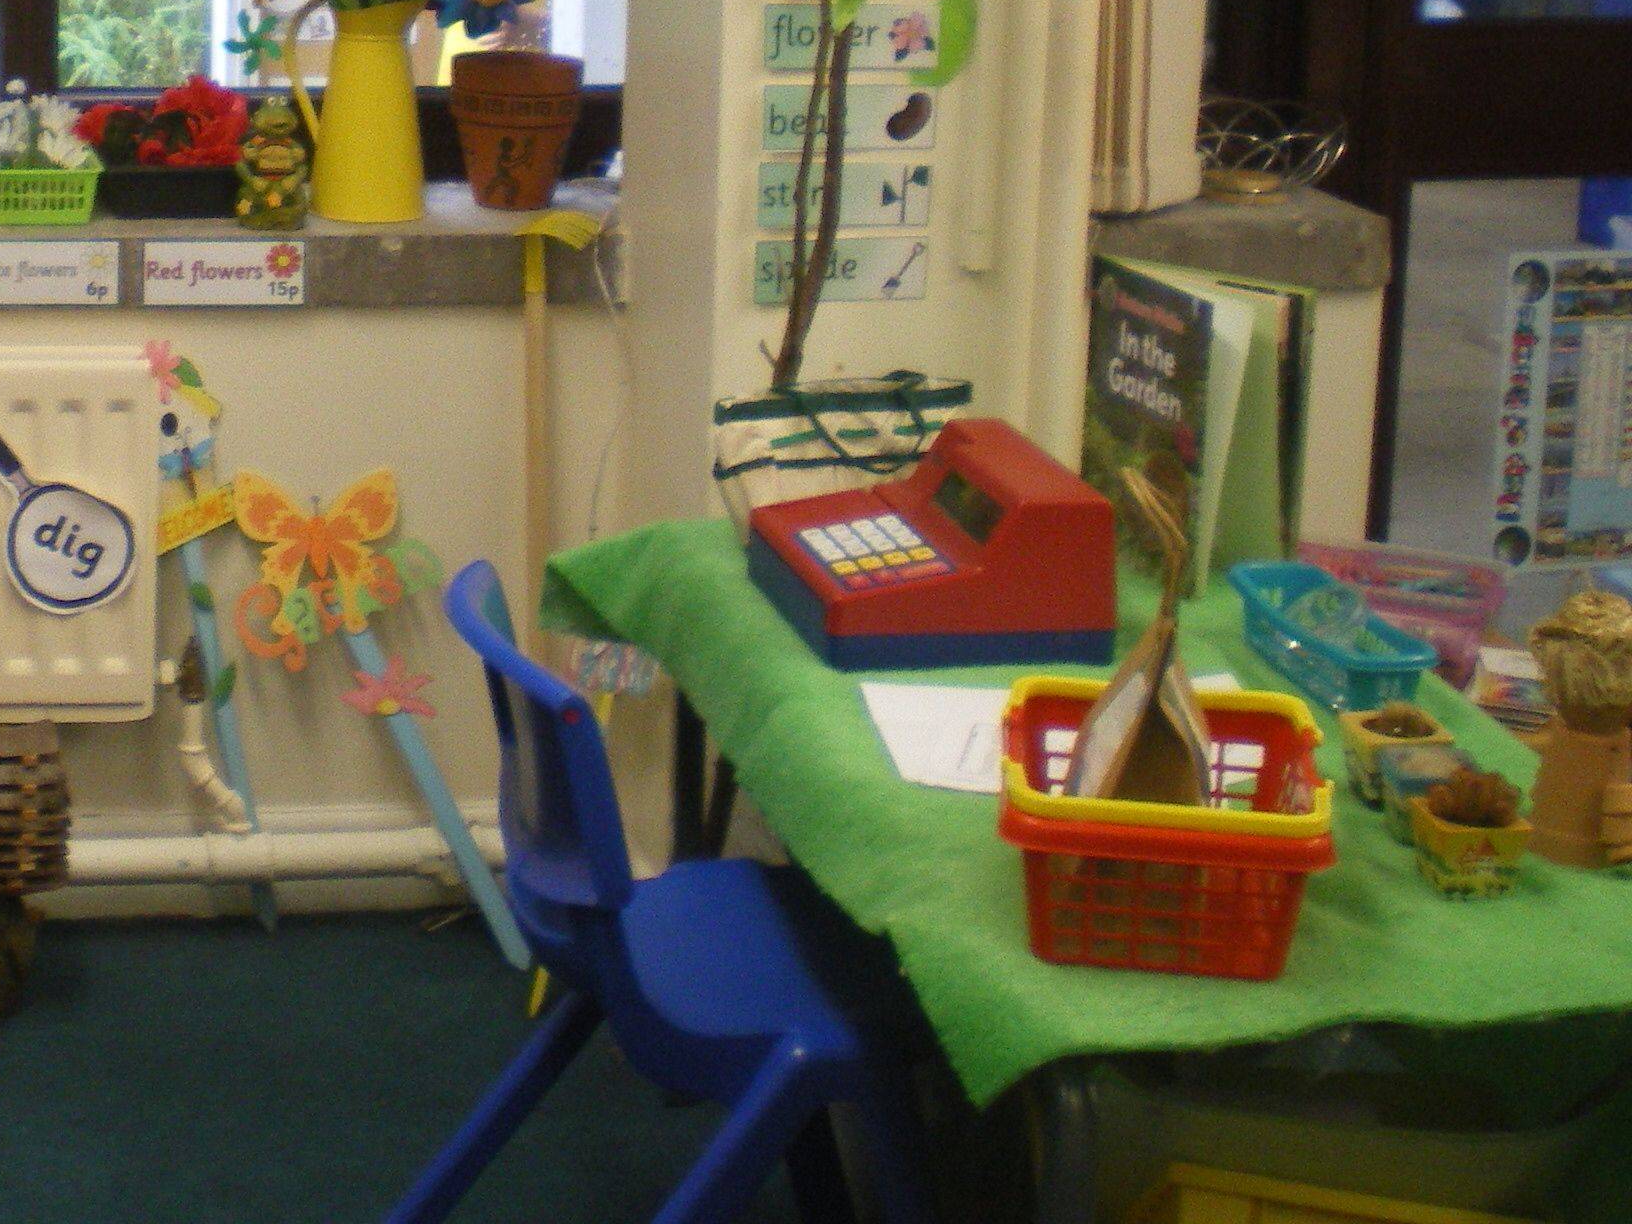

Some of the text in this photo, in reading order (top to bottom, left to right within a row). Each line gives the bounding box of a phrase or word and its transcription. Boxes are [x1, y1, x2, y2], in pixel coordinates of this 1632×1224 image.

[768, 13, 880, 61] floer
[770, 104, 848, 135] bea
[144, 259, 264, 287] Red flowers
[84, 281, 108, 301] 6p
[269, 281, 299, 302] 15p
[33, 514, 106, 579] dig
